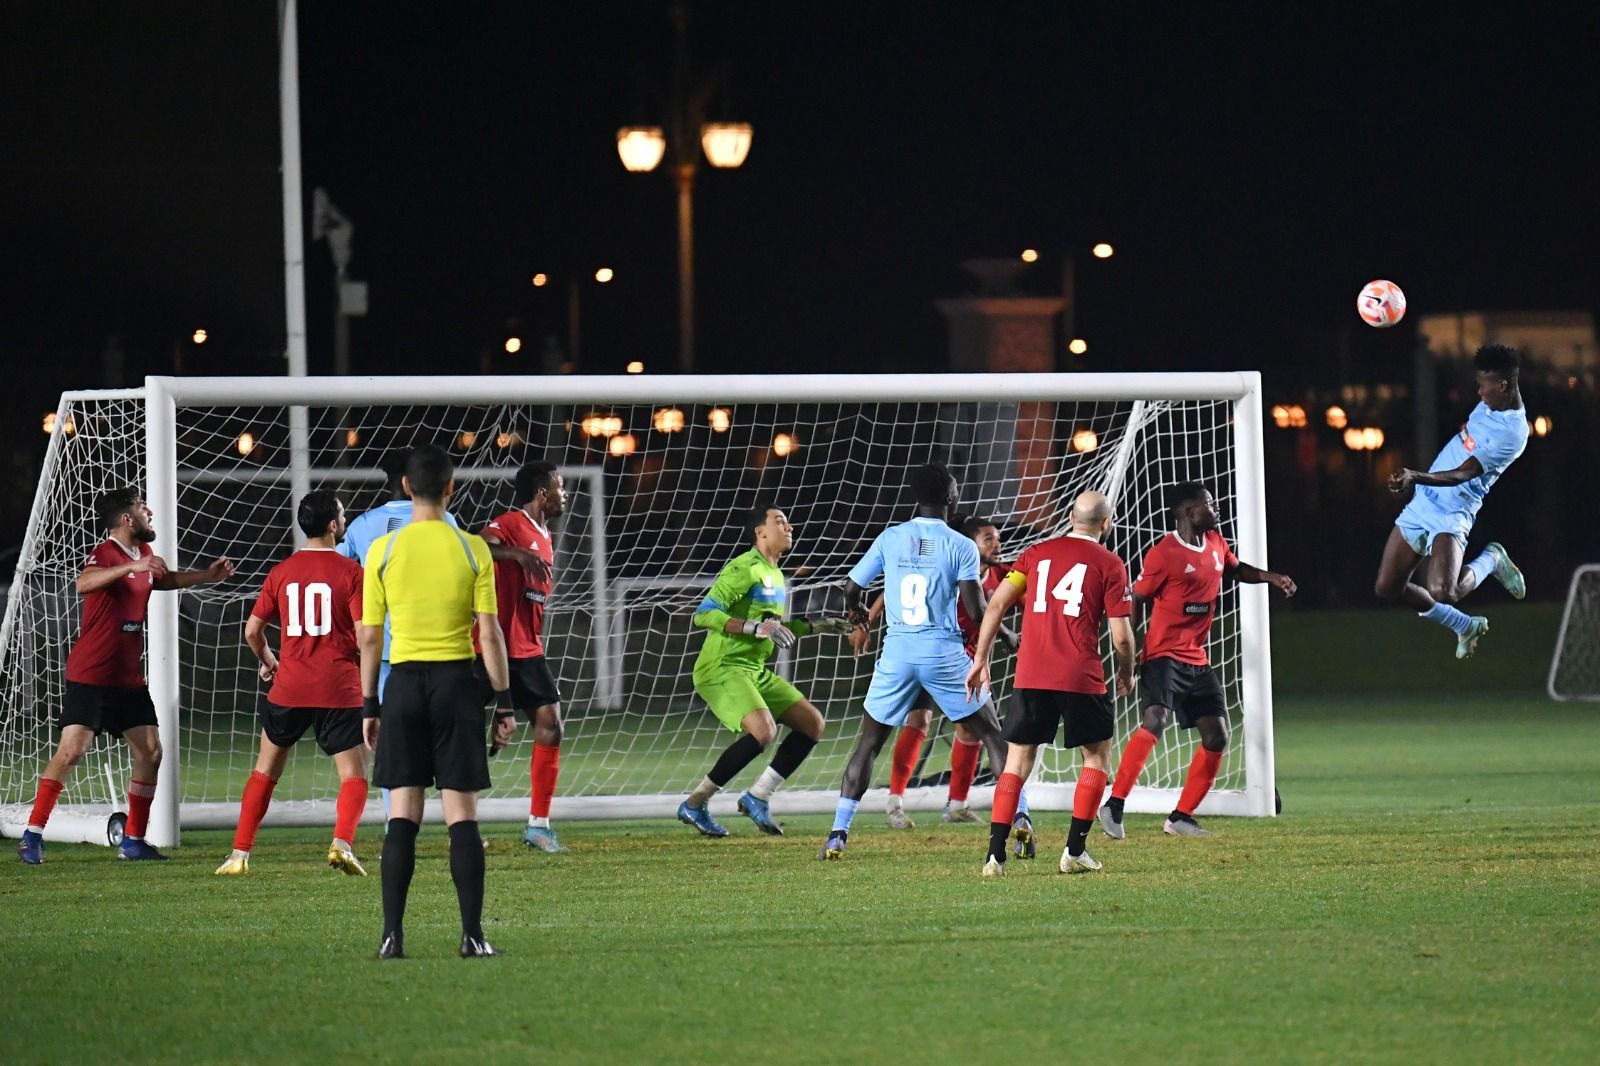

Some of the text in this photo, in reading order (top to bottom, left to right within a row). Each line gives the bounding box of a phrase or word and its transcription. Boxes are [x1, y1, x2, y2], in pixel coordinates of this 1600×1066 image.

[286, 582, 332, 637] 10
[900, 573, 928, 626] 9
[1033, 559, 1088, 618] 14
